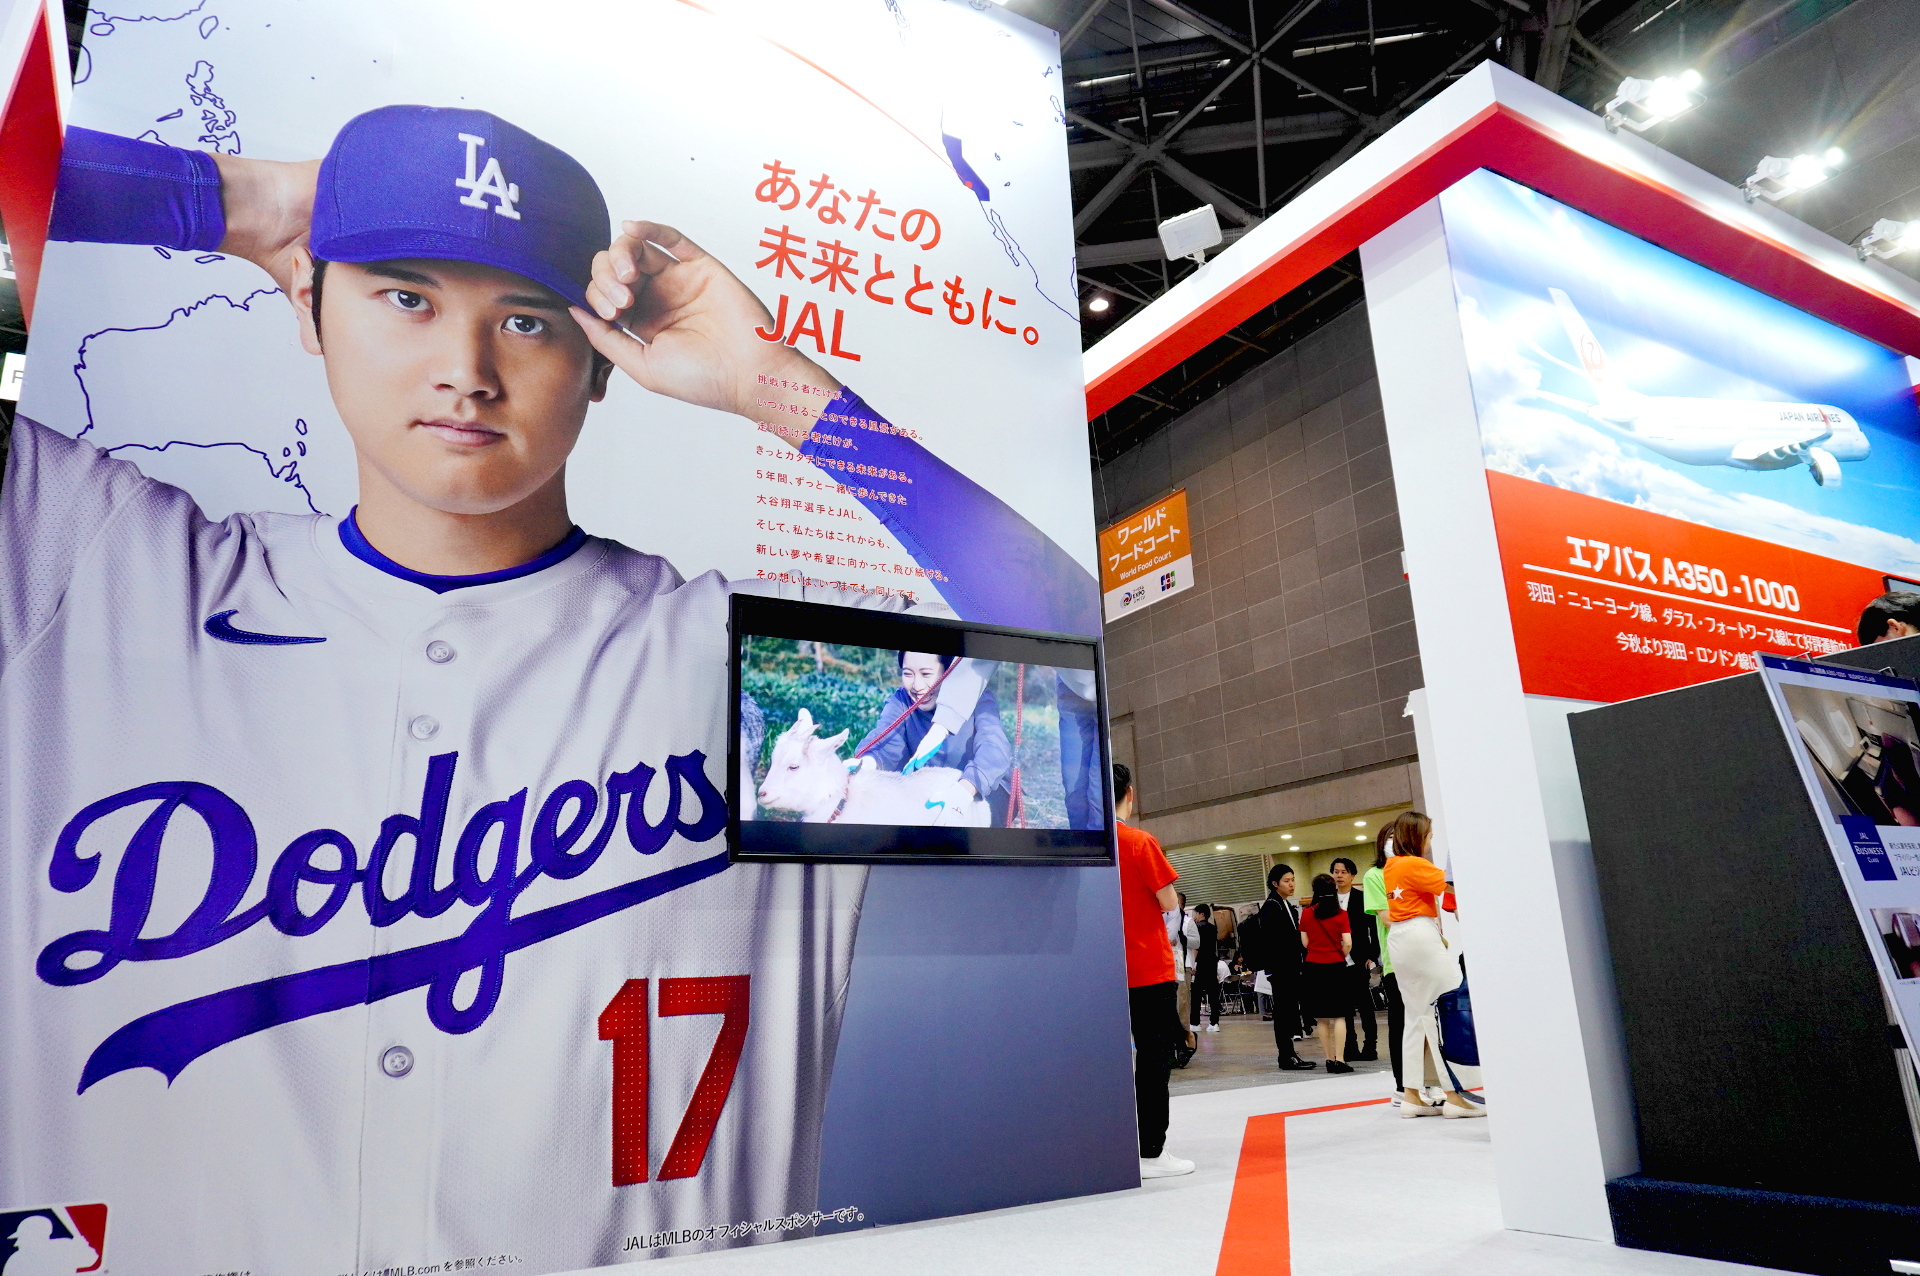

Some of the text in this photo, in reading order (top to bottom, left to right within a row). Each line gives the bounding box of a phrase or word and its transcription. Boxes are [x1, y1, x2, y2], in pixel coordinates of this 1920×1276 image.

[455, 132, 520, 220] LA
[755, 158, 941, 251] あなたの
[755, 224, 1039, 345] 未来とともに。
[754, 294, 862, 362] JAL
[757, 373, 848, 403] 挑戦する者だけが、
[757, 398, 923, 441] いつか見ることのできる風景がある。
[757, 421, 858, 451] 走り続ける者だけが、
[1779, 411, 1842, 423] JAPAN AIRLNES
[756, 445, 913, 484] きっとカタチにできる未来がある。
[756, 469, 907, 506] 5年間、ずっと一緒に歩んできた
[756, 494, 863, 521] 大谷翔平選手とJAL。
[1118, 507, 1167, 546] ワールド
[756, 519, 890, 549] そして、私たちはこれからも、
[1108, 525, 1181, 572] フードコート
[756, 543, 948, 582] 新しい夢や希望に向かって、飛び続ける。
[1120, 550, 1172, 580] World Food Court
[1566, 535, 1659, 586] エアバス
[1663, 556, 1728, 597] A350
[756, 569, 920, 601] その想いは、いつまでも、同じです。
[36, 751, 728, 1034] Dodgers
[597, 974, 750, 1186] 17
[622, 1206, 865, 1251] JALはMLBのオフィシャルスポンサーです。
[444, 1253, 524, 1271] を参照ください。
